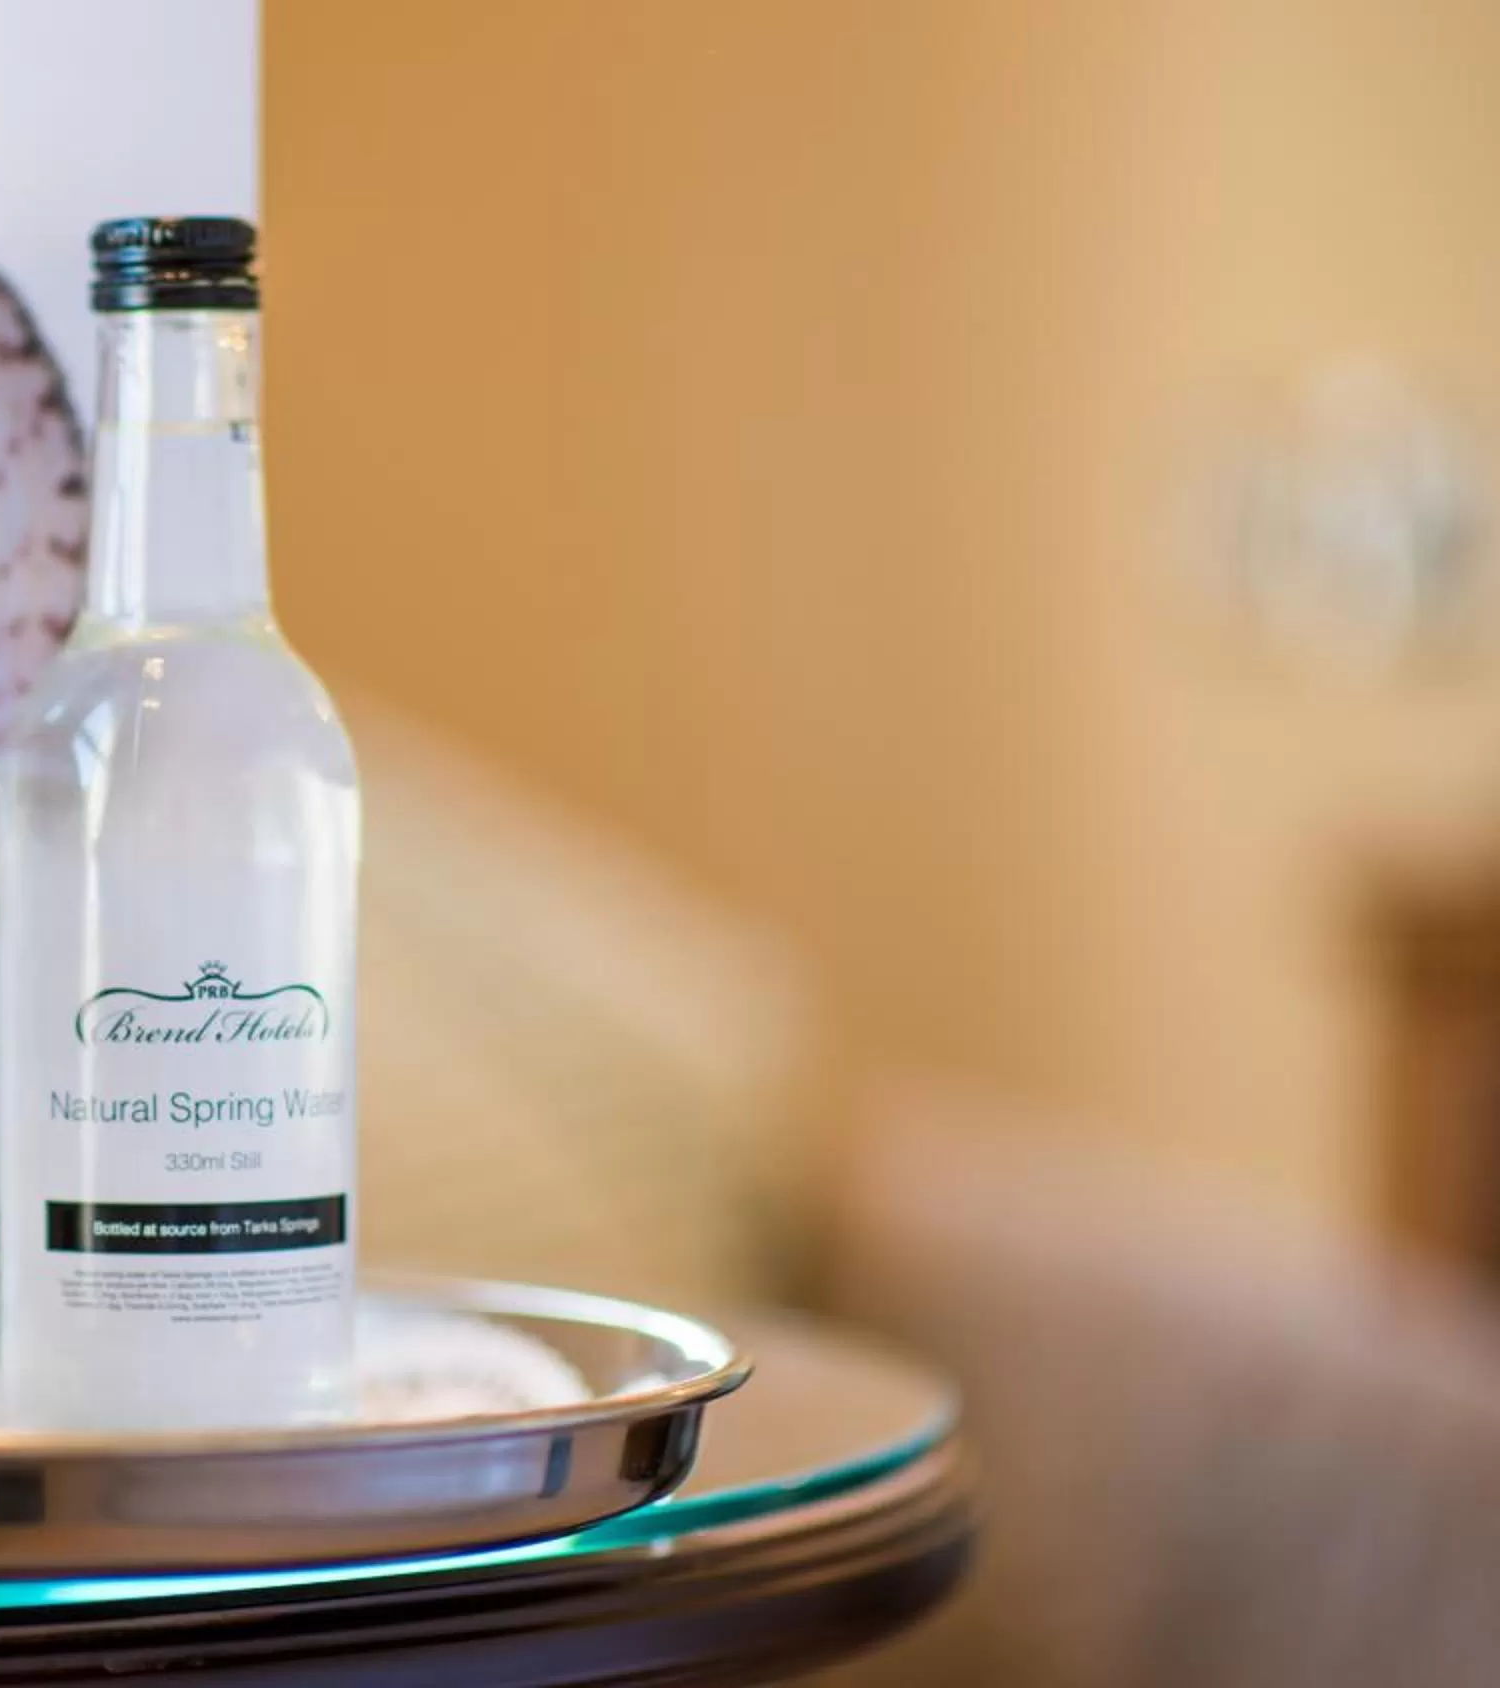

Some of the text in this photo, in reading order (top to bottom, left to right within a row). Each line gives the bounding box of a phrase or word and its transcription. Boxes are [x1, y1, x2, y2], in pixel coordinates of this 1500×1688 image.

[197, 985, 229, 999] PRB
[94, 1005, 315, 1043] Brend Hotels
[50, 1090, 157, 1123] Natural
[169, 1091, 274, 1128] Spring
[165, 1151, 262, 1172] 330ml Still
[93, 1219, 140, 1237] Bottled
[143, 1221, 157, 1237] at
[160, 1223, 207, 1237] source
[209, 1219, 241, 1235] from
[243, 1218, 278, 1234] Tarka
